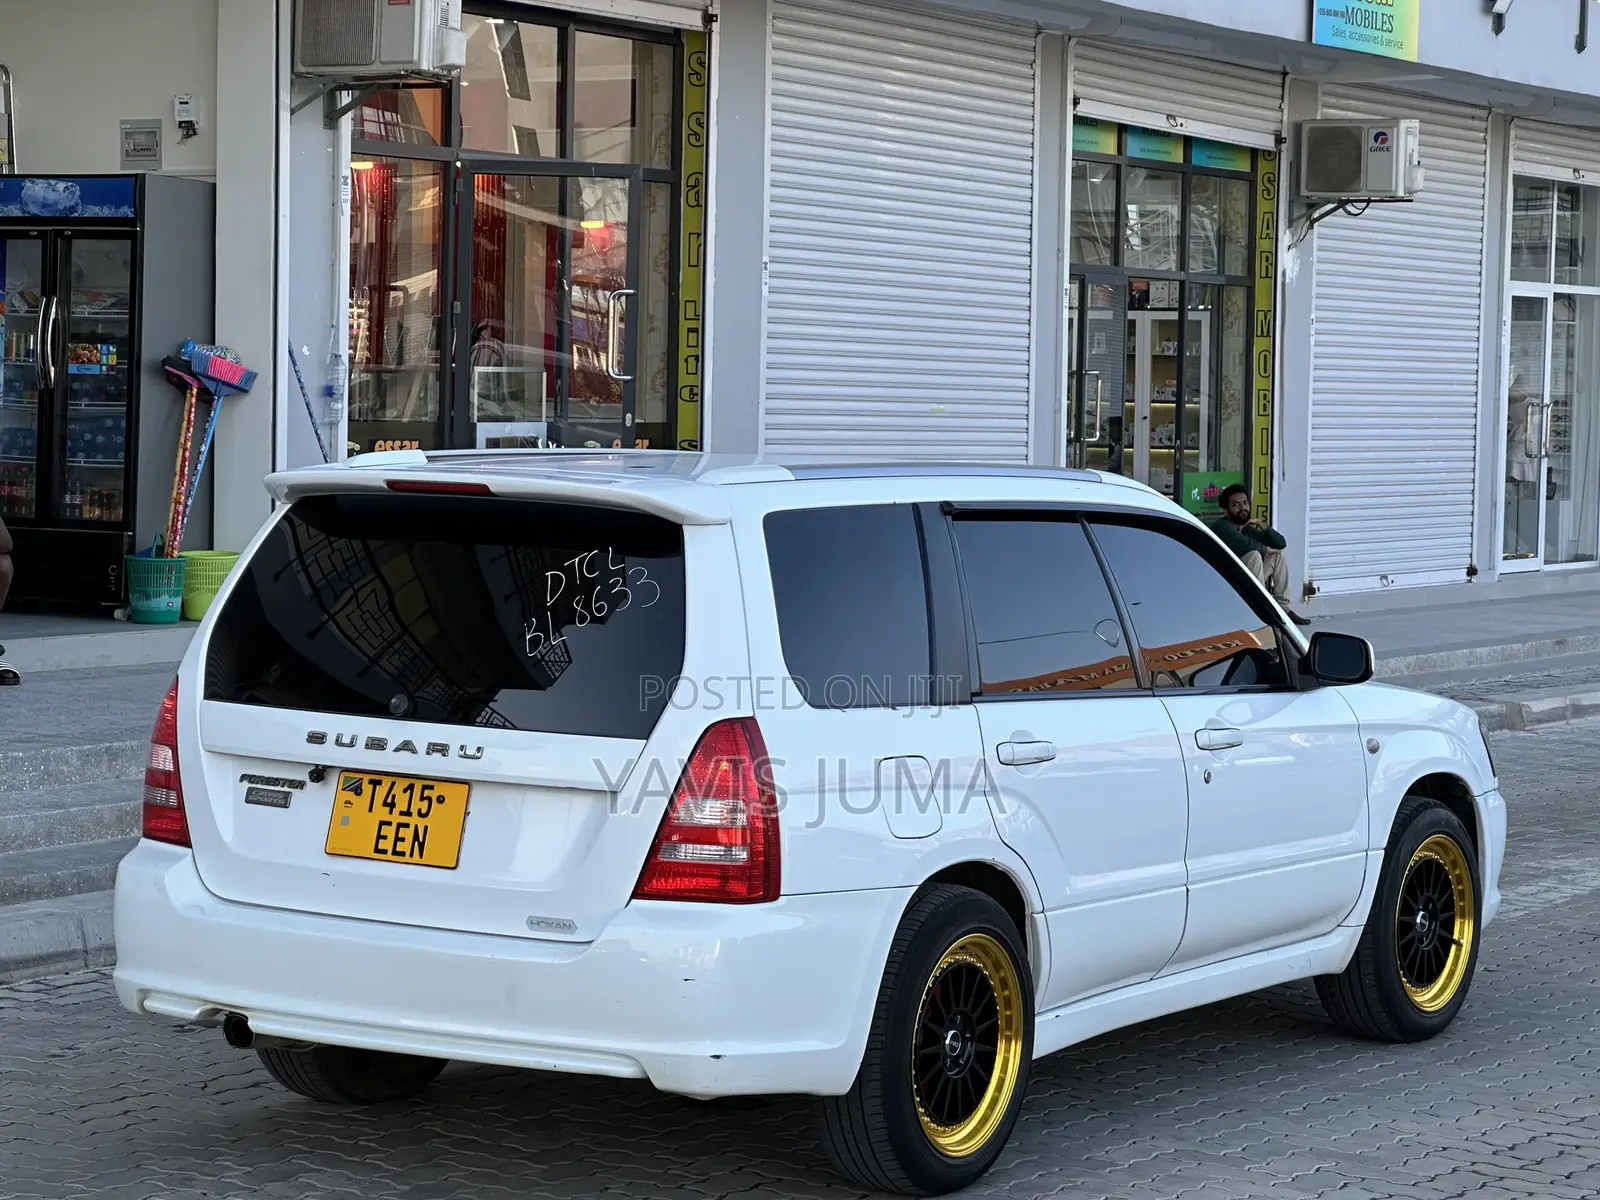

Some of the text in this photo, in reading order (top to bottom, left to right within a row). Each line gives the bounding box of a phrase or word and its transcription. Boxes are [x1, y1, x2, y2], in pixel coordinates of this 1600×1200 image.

[1344, 4, 1394, 33] MOBILES
[1331, 24, 1348, 40] Sales,
[1348, 30, 1379, 44] accessories
[1384, 37, 1404, 50] service
[1369, 145, 1392, 153] GREE
[612, 438, 650, 450] ear
[573, 566, 660, 627] 8633
[305, 730, 485, 760] SUBARU
[239, 773, 307, 790] FORESTER
[366, 778, 435, 819] T415
[373, 820, 429, 860] EEN
